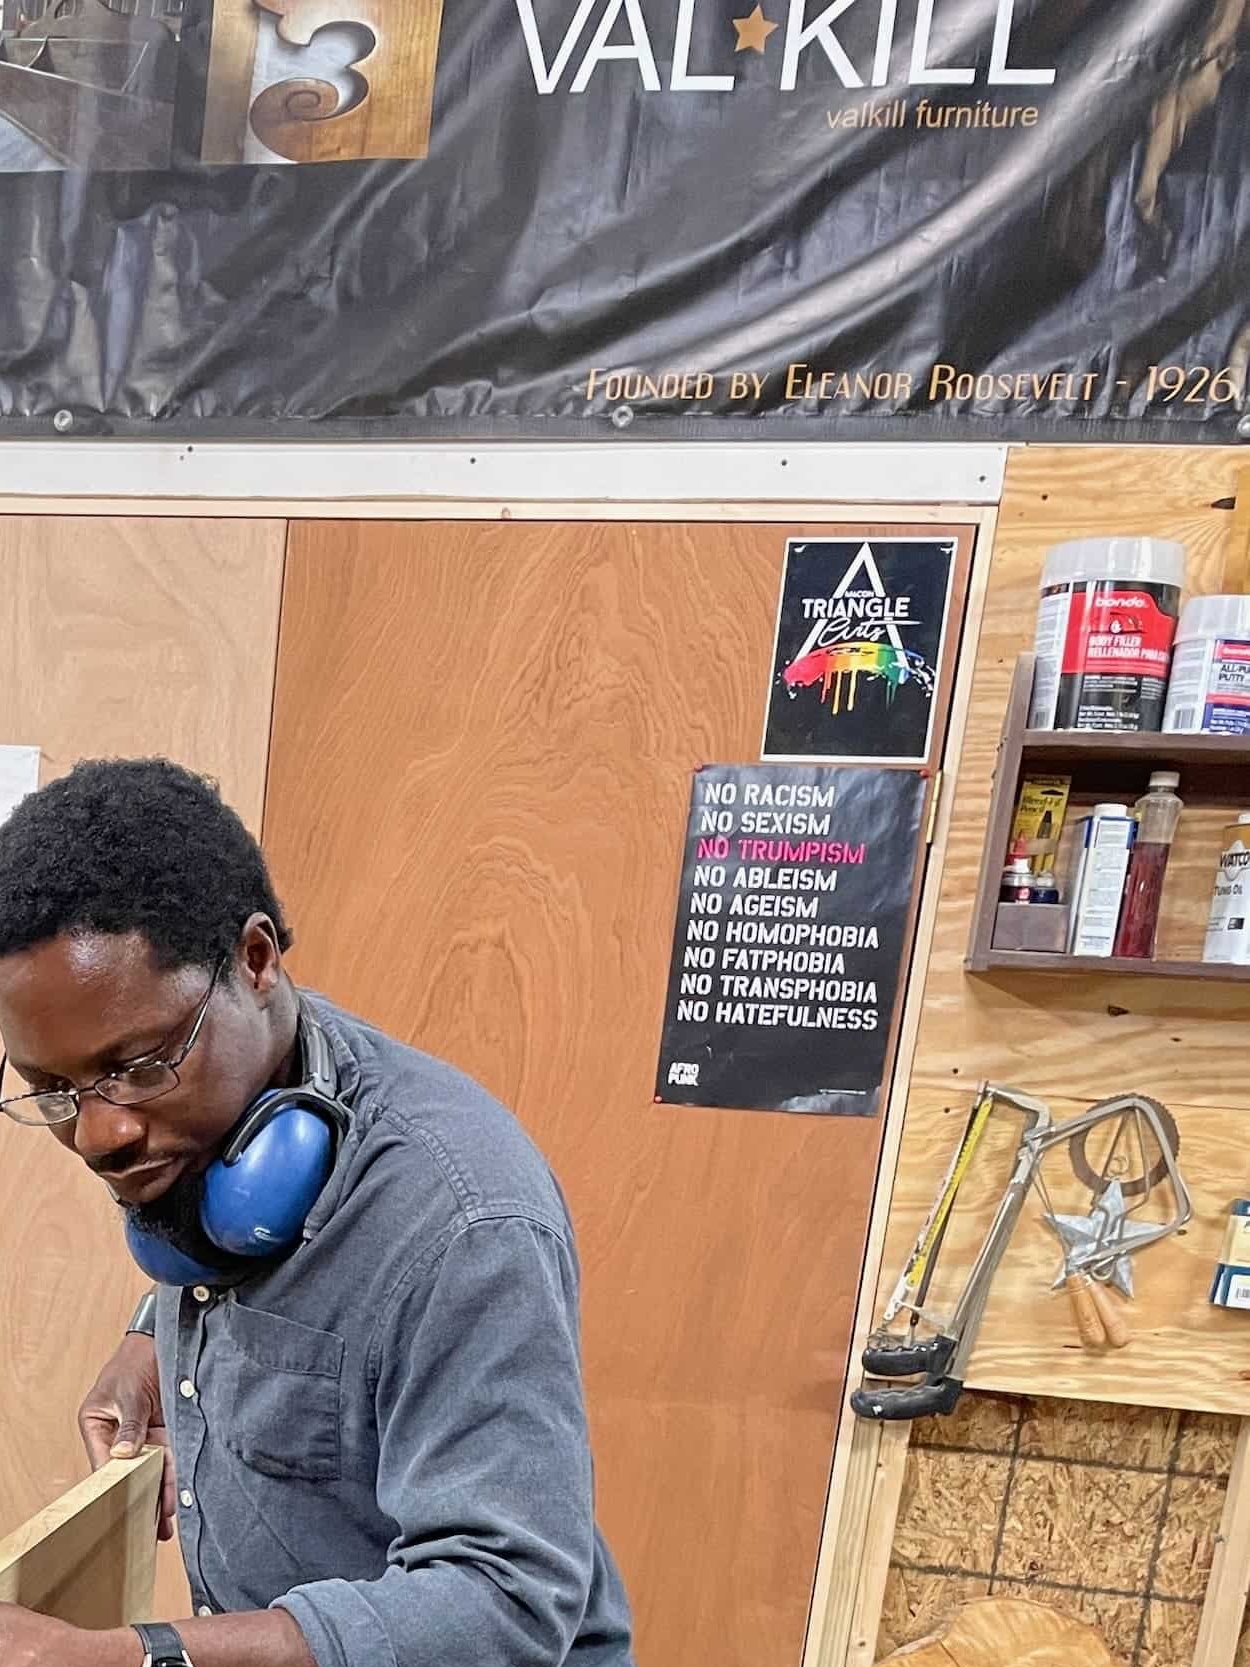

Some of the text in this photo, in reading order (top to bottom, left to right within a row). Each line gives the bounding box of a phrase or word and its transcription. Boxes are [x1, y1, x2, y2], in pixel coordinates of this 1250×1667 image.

[516, 0, 1056, 95] VAL KILL
[827, 99, 1039, 129] valkill furniture
[730, 372, 771, 400] BY
[785, 362, 913, 401] ELEANOR
[928, 364, 1098, 401] ROOSEVELT
[1146, 365, 1238, 404] 1926
[802, 597, 911, 619] TRIANGLE
[705, 783, 835, 808] NO RACISM
[701, 811, 831, 836] NO SEXISM
[697, 838, 866, 864] NO TRUMPISM
[693, 865, 838, 892] NO ABLEISM
[690, 892, 819, 919] NO AGEISM
[686, 919, 879, 949] NO HOMOPHOBIA
[683, 946, 845, 975] NO FATPHOBIA
[680, 973, 878, 1004] NO TRANSPHOBIA
[677, 999, 880, 1031] NO HATEFULNESS
[670, 1062, 699, 1074] AFRO
